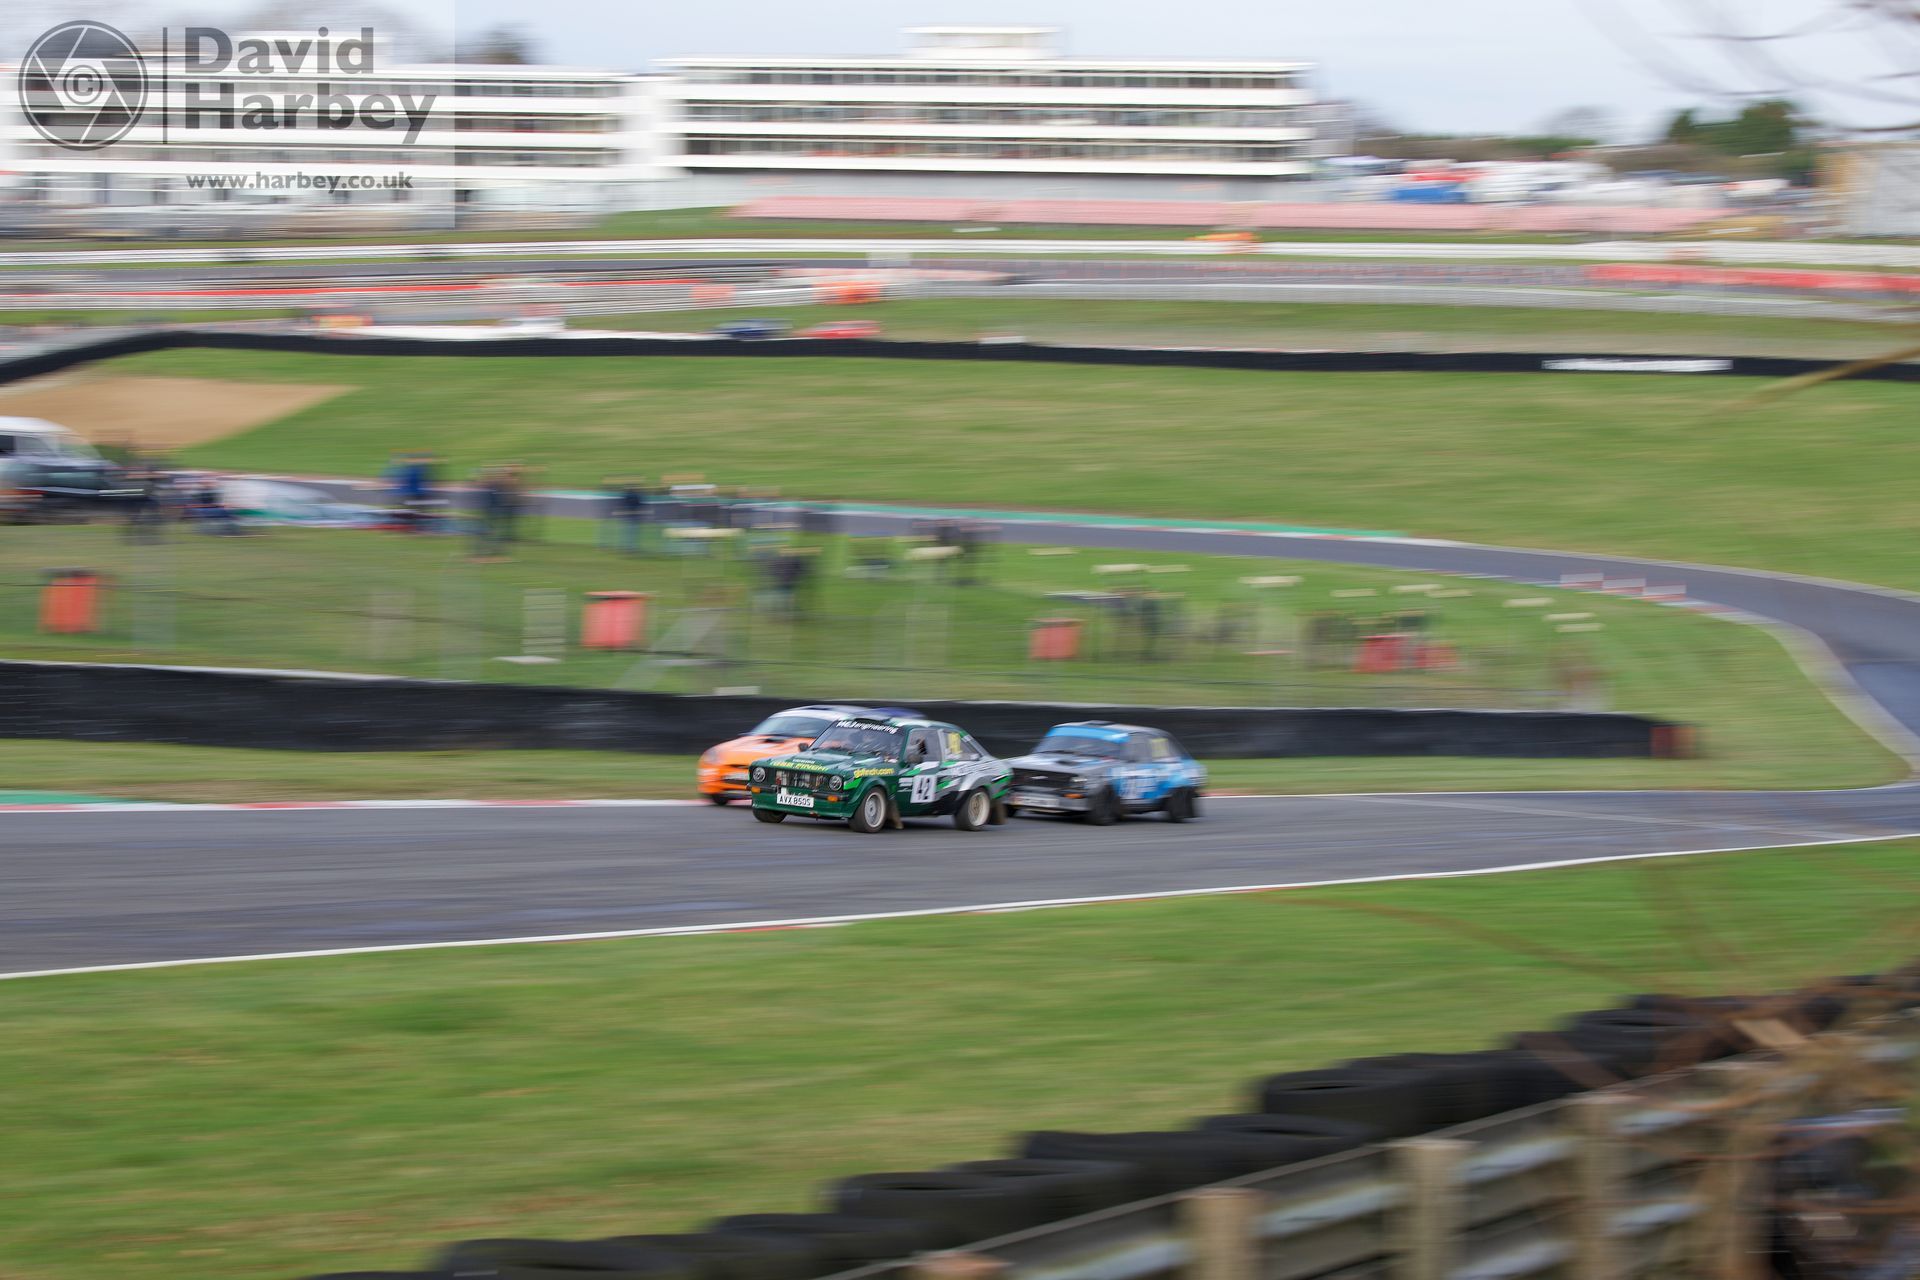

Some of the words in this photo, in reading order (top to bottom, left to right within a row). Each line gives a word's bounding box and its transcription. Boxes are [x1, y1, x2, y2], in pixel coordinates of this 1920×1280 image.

[915, 777, 931, 800] 42
[779, 795, 792, 804] AVX
[793, 796, 811, 806] 850S
